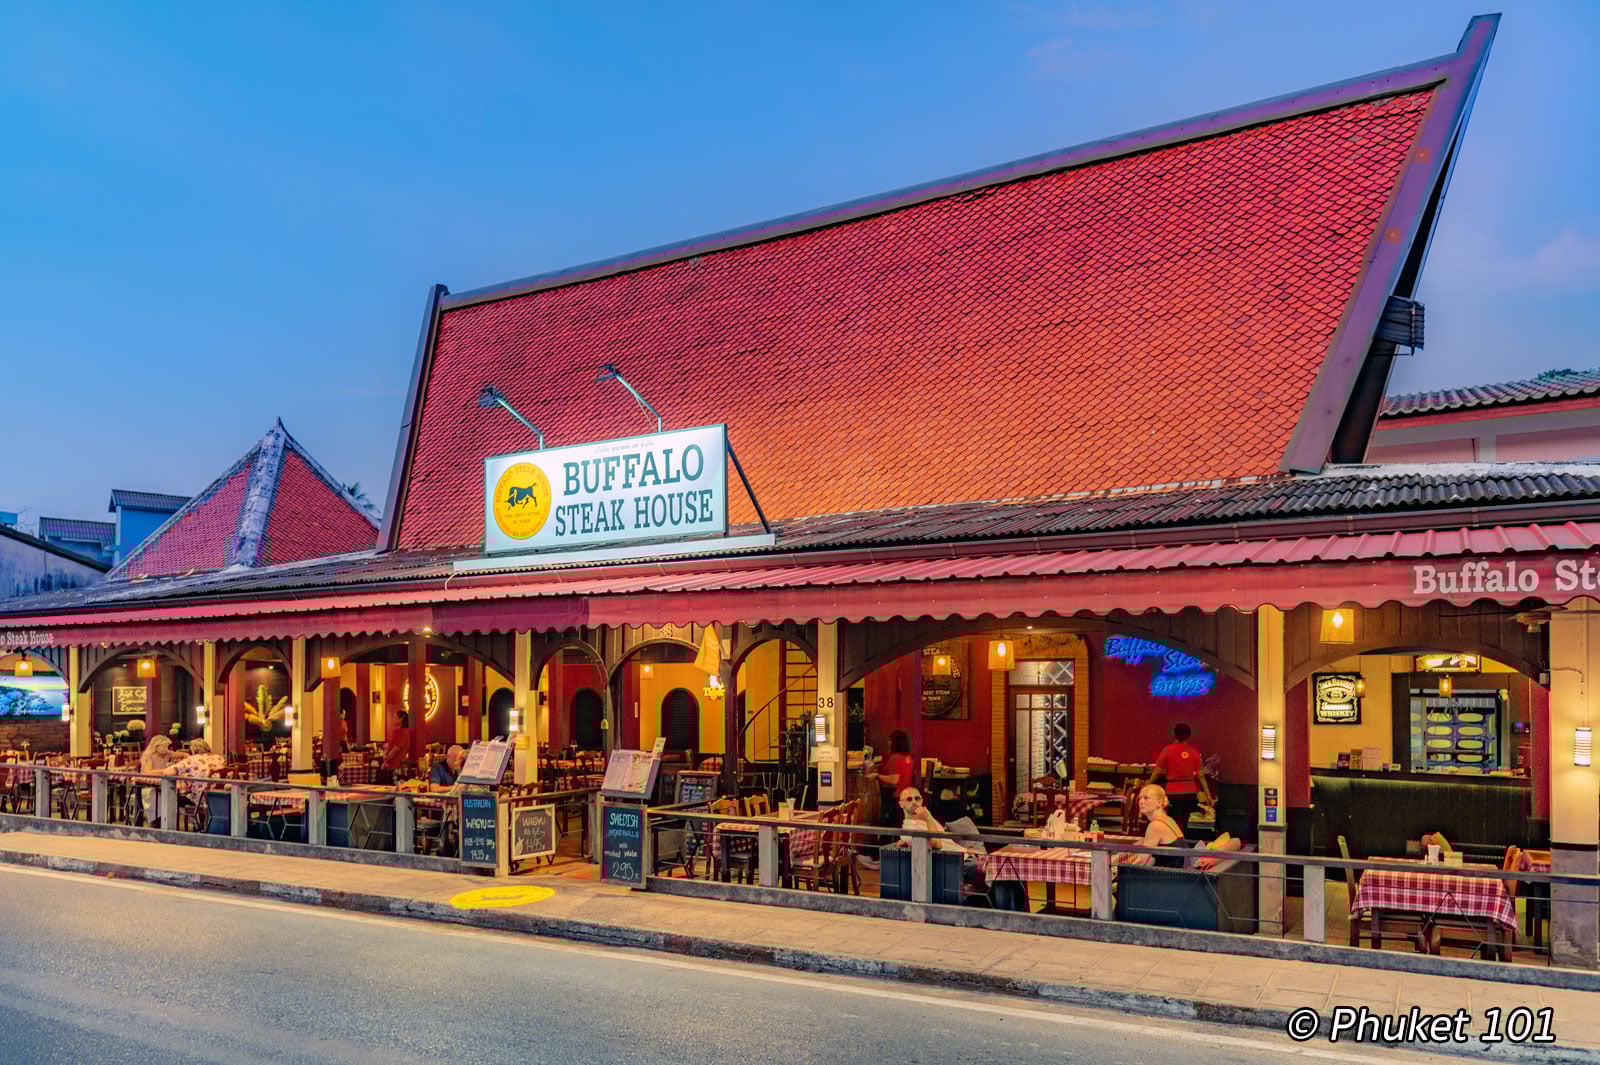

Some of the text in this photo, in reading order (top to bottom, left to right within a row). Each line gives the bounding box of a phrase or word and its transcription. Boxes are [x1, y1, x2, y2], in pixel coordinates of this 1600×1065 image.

[563, 444, 704, 496] BUFFALO
[555, 499, 625, 537] STEAK
[634, 489, 713, 529] HOUSE
[1413, 559, 1600, 594] Buffalo St
[7, 631, 28, 645] Steak
[30, 630, 54, 645] House
[819, 697, 833, 708] 38
[465, 818, 487, 829] WAGYU
[609, 812, 639, 828] SWEDISH
